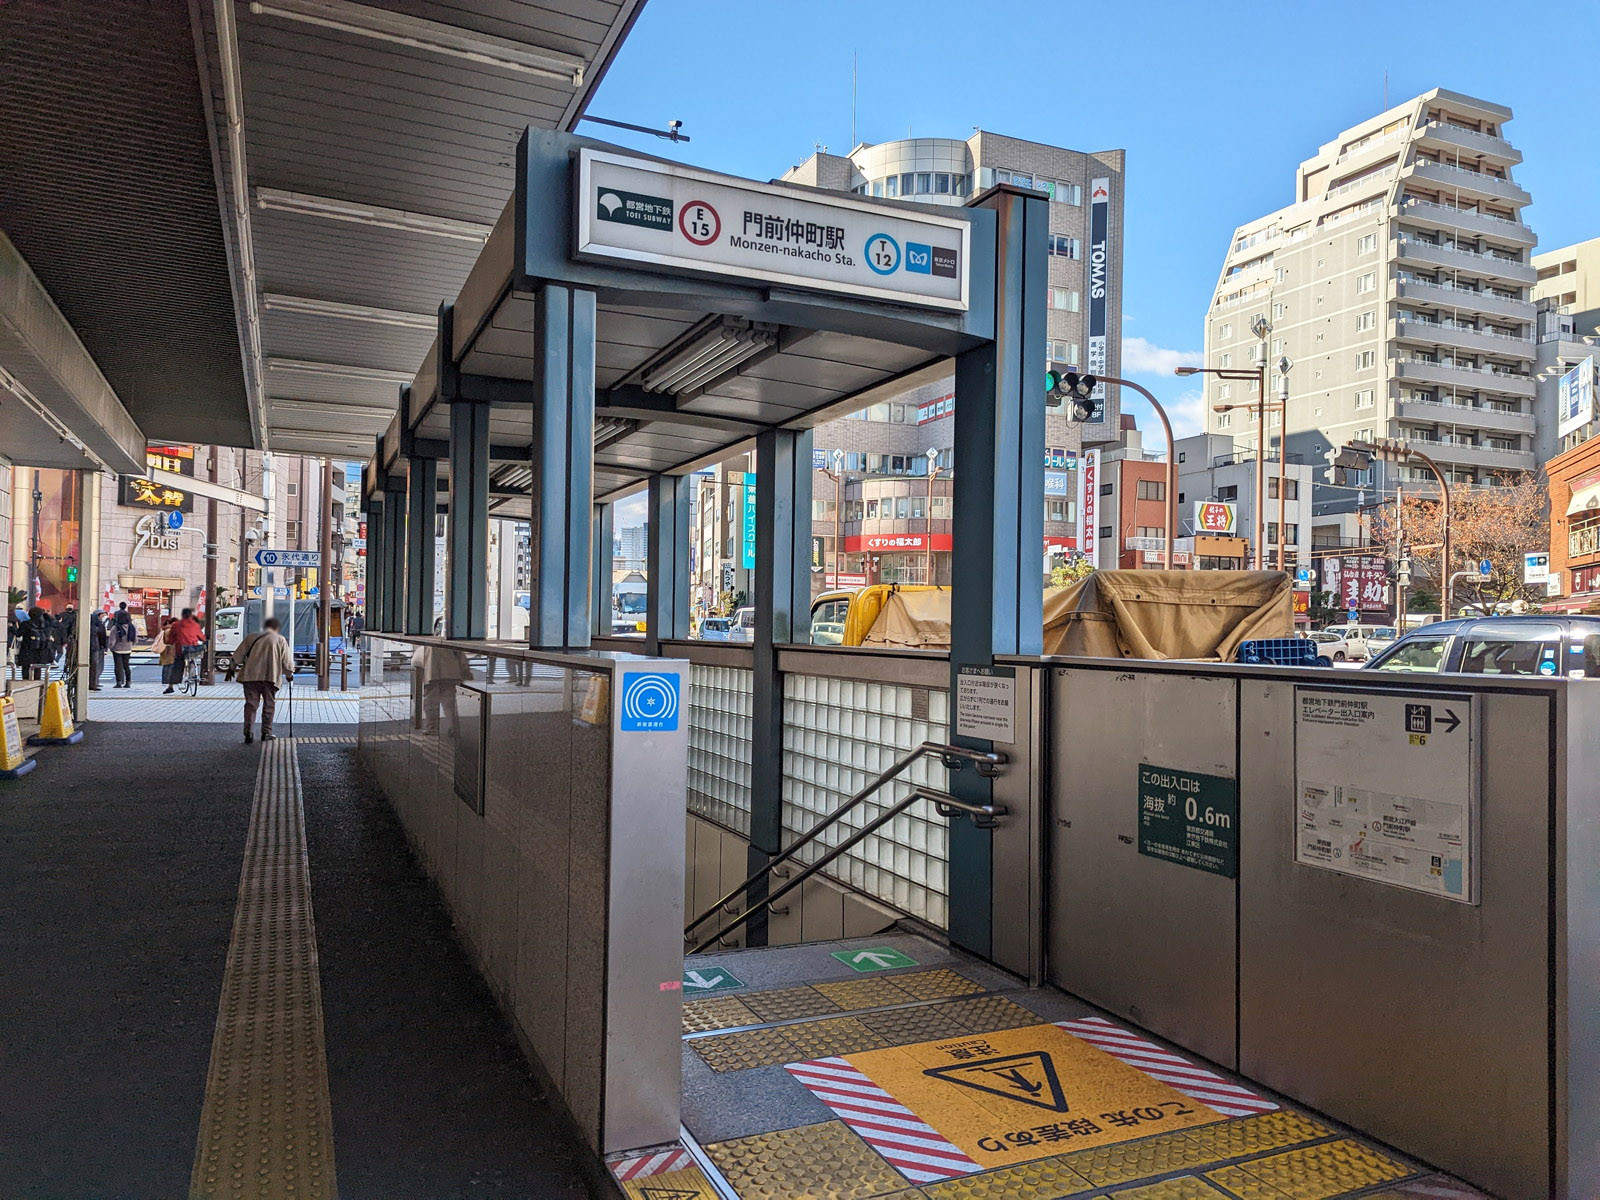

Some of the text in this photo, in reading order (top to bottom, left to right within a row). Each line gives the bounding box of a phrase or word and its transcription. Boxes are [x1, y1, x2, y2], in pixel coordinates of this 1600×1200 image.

[626, 200, 672, 216] 都営地下鉄
[697, 209, 704, 220] E
[626, 211, 671, 225] TOEI SUBWAY
[692, 222, 709, 236] 15
[743, 211, 845, 251] 門前仲町駅
[730, 235, 856, 267] Monzen-nakacho Sta.
[880, 240, 887, 252] T
[876, 253, 892, 267] 12
[1091, 240, 1105, 299] TOMAS
[1086, 470, 1094, 550] くすりの福太郎
[1206, 514, 1227, 528] 王将
[868, 538, 922, 547] くすりの福太郎
[265, 554, 276, 563] 10
[281, 552, 319, 561] 永代通り
[1302, 697, 1368, 710] 都営地下鉄門前仲町駅
[1303, 706, 1375, 720] エレベーター出入口案内
[1419, 735, 1426, 745] 6
[1142, 771, 1201, 793] この出入口は
[1143, 793, 1231, 829] 海抜 約 0.6m
[935, 1040, 987, 1050] Caution
[946, 1044, 1001, 1060] 注意
